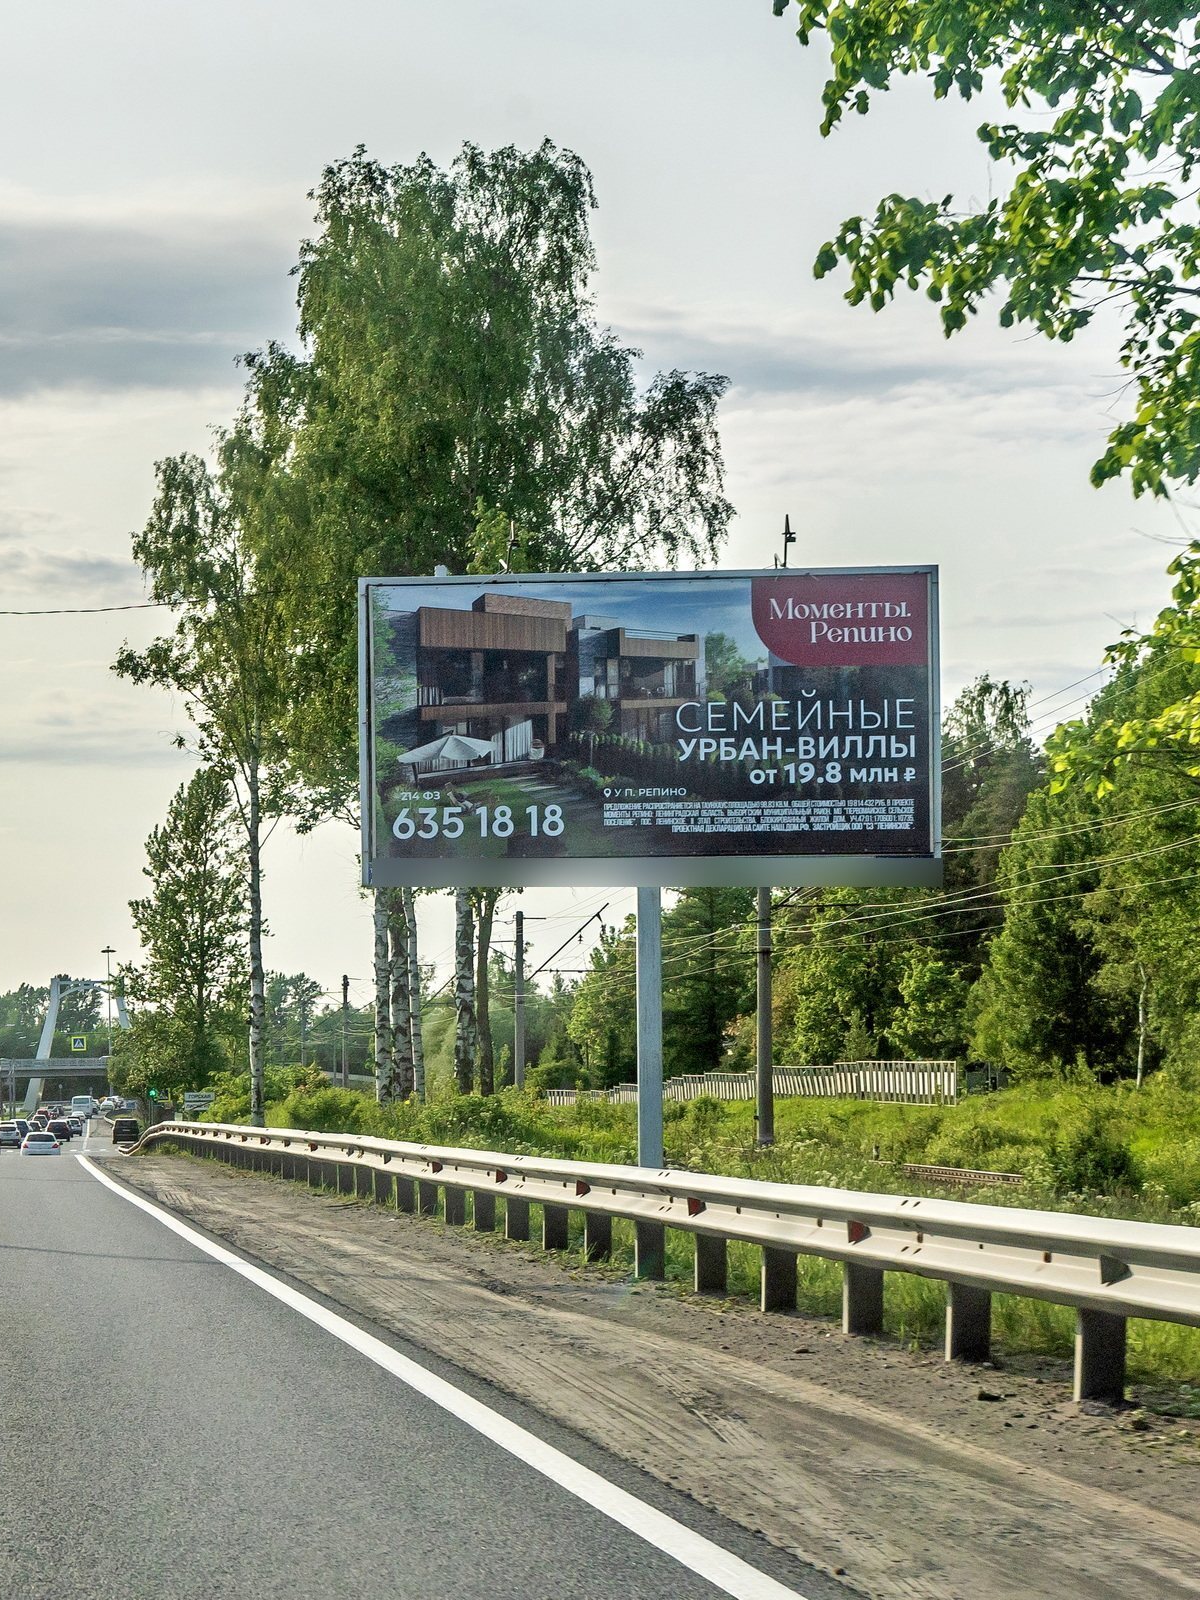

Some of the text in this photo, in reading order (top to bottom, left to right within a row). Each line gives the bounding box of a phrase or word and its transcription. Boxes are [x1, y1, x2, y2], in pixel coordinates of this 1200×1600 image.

[810, 621, 912, 644] Репино
[676, 689, 916, 732] СЕМЕЙНЫЕ
[678, 735, 916, 762] УРБАН-ВИЛЛЫ
[784, 762, 842, 784] 19.8
[400, 791, 440, 801] 214 ФЗ
[638, 787, 687, 797] РЕПИНО
[392, 804, 565, 840] 635 18 18
